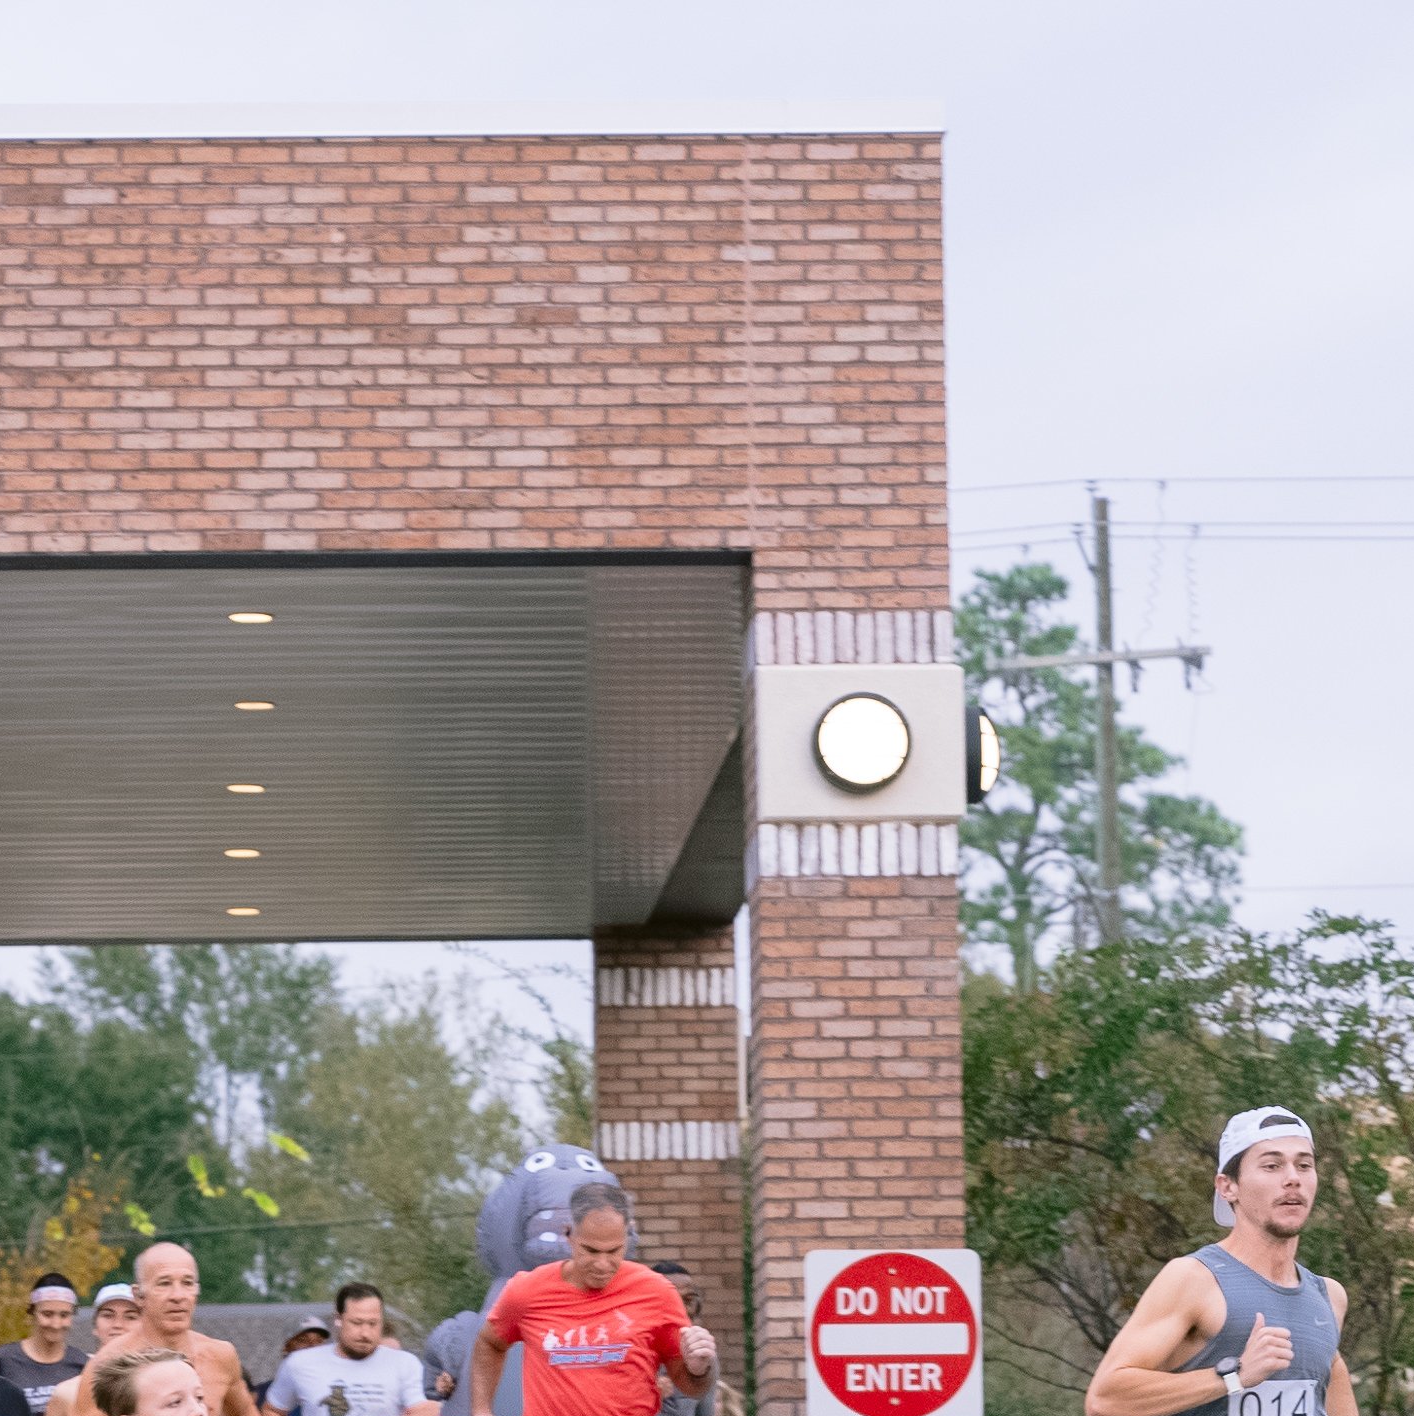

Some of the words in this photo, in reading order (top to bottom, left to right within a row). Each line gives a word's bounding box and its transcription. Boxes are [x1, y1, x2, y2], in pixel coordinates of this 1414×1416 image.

[836, 1287, 879, 1316] DO
[891, 1286, 950, 1315] NOT
[845, 1363, 943, 1392] ENTER
